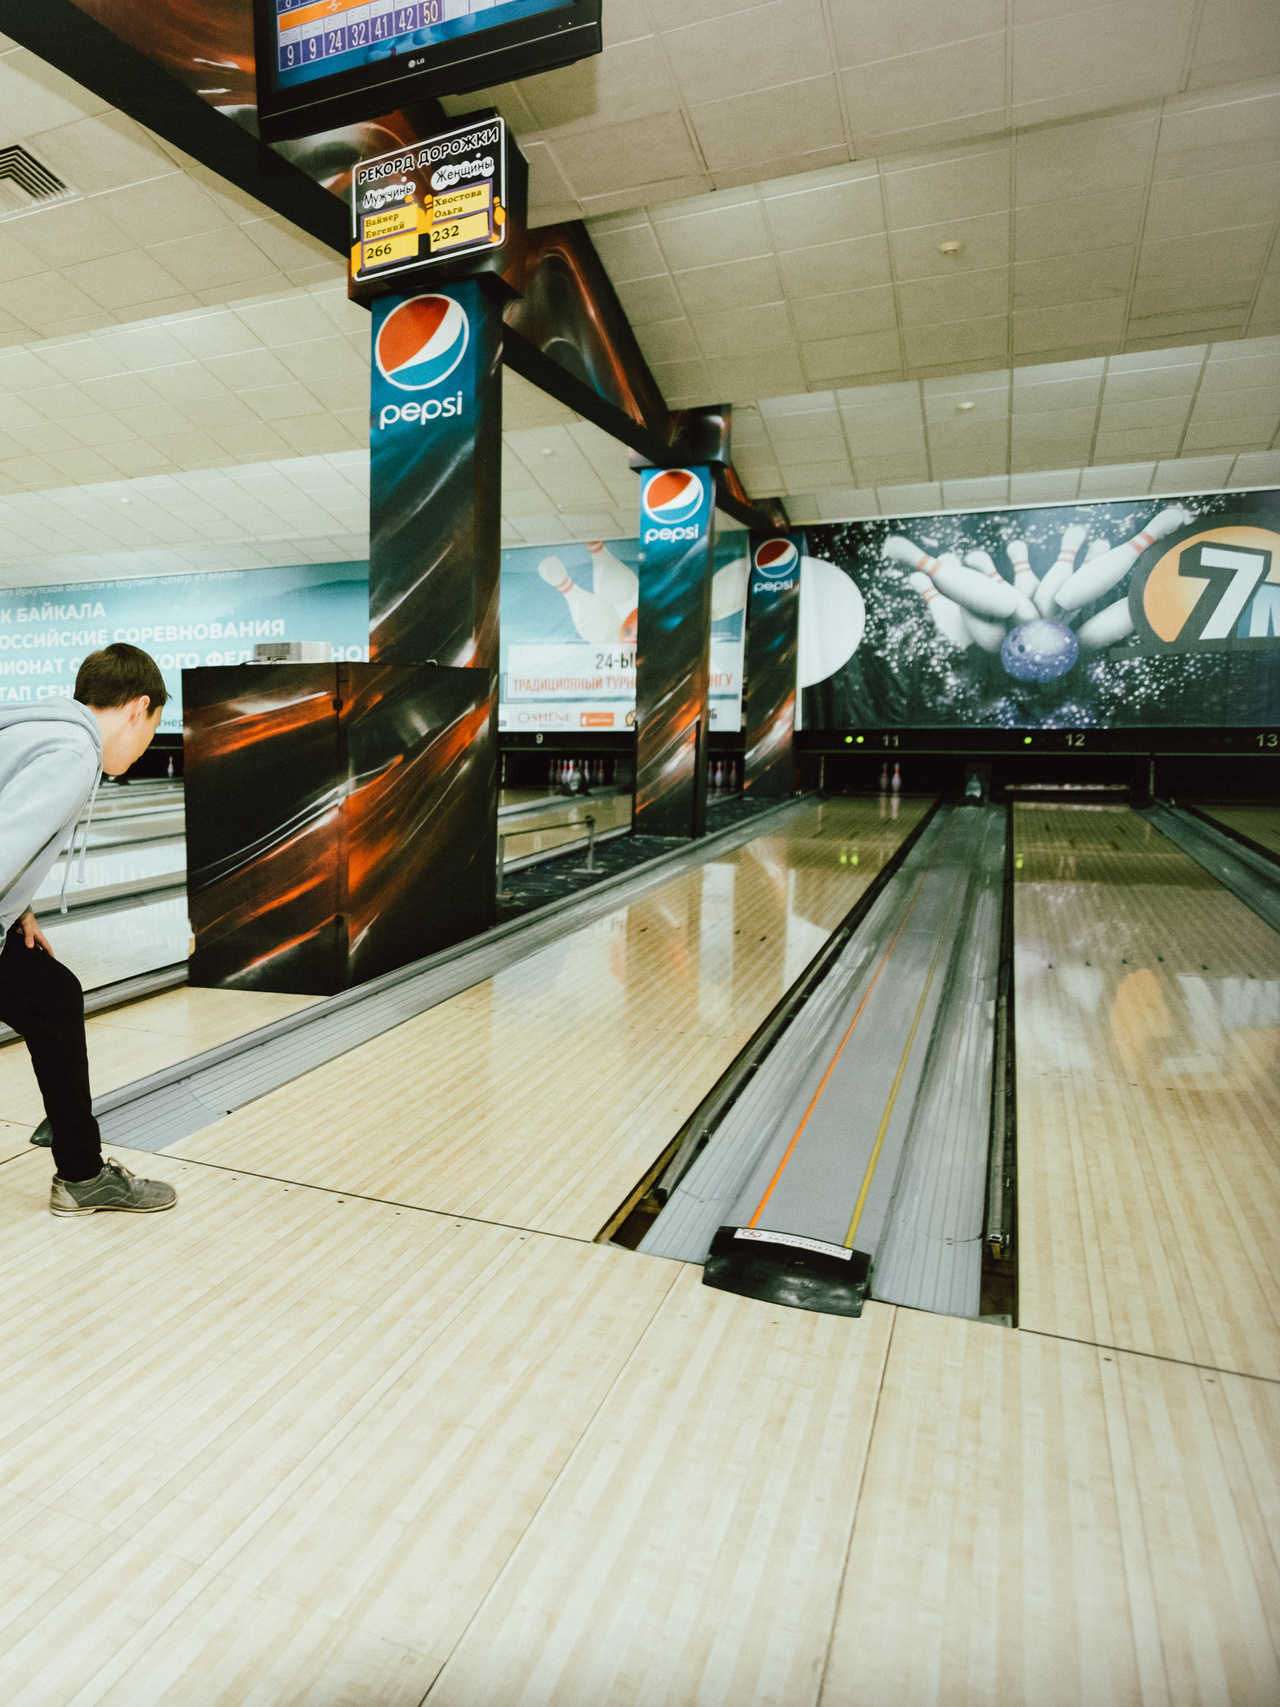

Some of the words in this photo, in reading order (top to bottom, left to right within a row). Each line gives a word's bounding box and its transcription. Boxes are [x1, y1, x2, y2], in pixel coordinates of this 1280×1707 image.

[287, 45, 294, 66] 9
[309, 38, 317, 59] 9
[329, 30, 342, 54] 24
[351, 22, 366, 46] 32
[375, 15, 388, 38] 41
[399, 7, 414, 31] 42
[423, 0, 439, 24] 50
[358, 155, 415, 185] РЕКОРД
[418, 127, 499, 166] ДОРОЖКИ
[363, 183, 414, 207] Мужчины
[436, 159, 494, 183] Женщины
[365, 213, 399, 229] Вайнер
[434, 189, 482, 207] Хвостова
[365, 222, 405, 239] Евгений
[434, 206, 463, 219] Ольга
[366, 243, 392, 260] 266
[432, 225, 460, 243] 232
[380, 390, 463, 430] pepsi
[644, 523, 699, 545] pepsi
[754, 579, 793, 594] pepsi
[17, 602, 106, 623] БАЙКАЛА
[113, 619, 285, 643] СОРЕВНОВАНИЯ
[596, 652, 637, 670] 24-Ы
[36, 685, 74, 701] СЕН
[513, 674, 603, 692] ТРАДИЦИОННЫЙ
[606, 674, 636, 689] ТУРН
[536, 733, 543, 744] 9
[883, 735, 899, 747] 11
[1065, 734, 1086, 747] 12
[1256, 734, 1278, 747] 13
